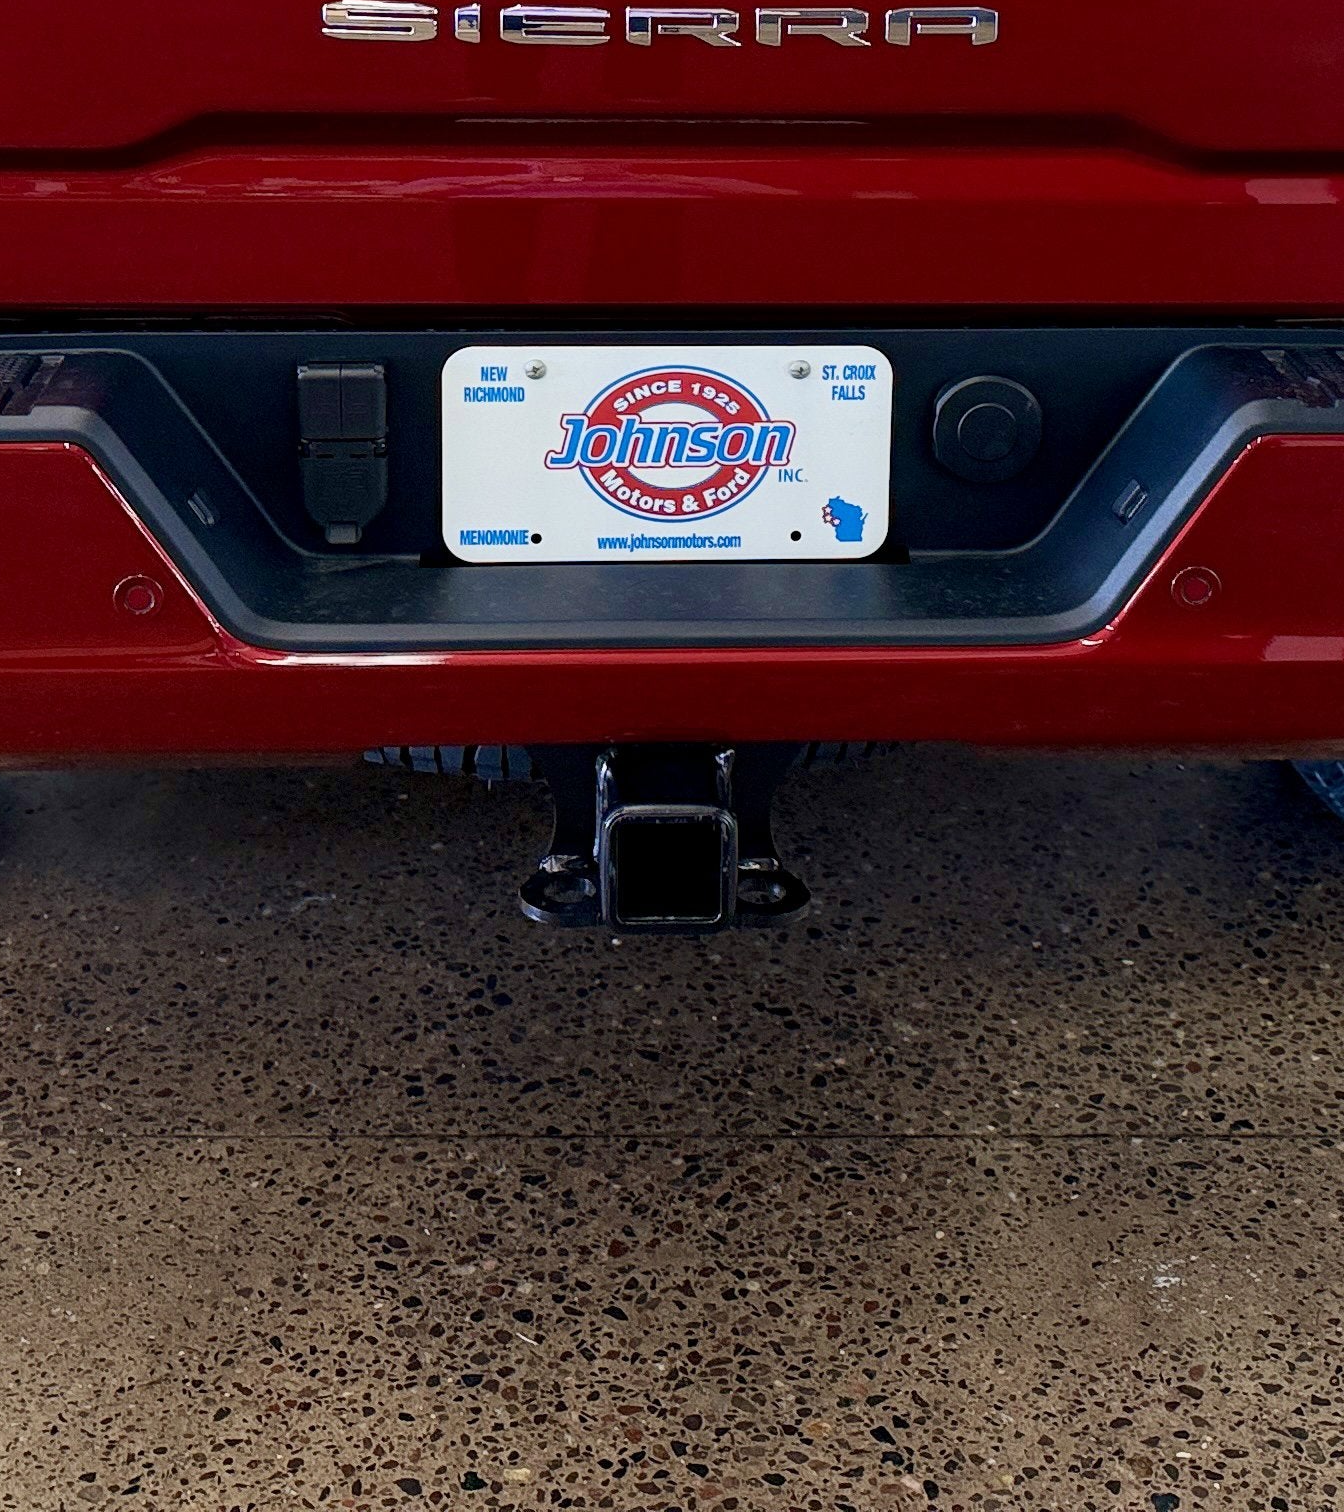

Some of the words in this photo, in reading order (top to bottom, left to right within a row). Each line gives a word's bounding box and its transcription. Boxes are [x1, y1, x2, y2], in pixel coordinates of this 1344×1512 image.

[480, 366, 508, 382] NEW
[821, 364, 840, 381] ST.
[842, 364, 877, 381] CROIX
[463, 386, 526, 403] RICHMOND
[613, 379, 682, 413] SINCE
[690, 381, 742, 416] 1925
[831, 385, 866, 401] FALLS
[548, 416, 793, 467] Johnson
[599, 468, 677, 514] Motors
[681, 494, 701, 513] &
[703, 466, 751, 508] Ford
[459, 529, 530, 546] MENOMONIE
[597, 532, 742, 553] www.johnsonmotors.com
